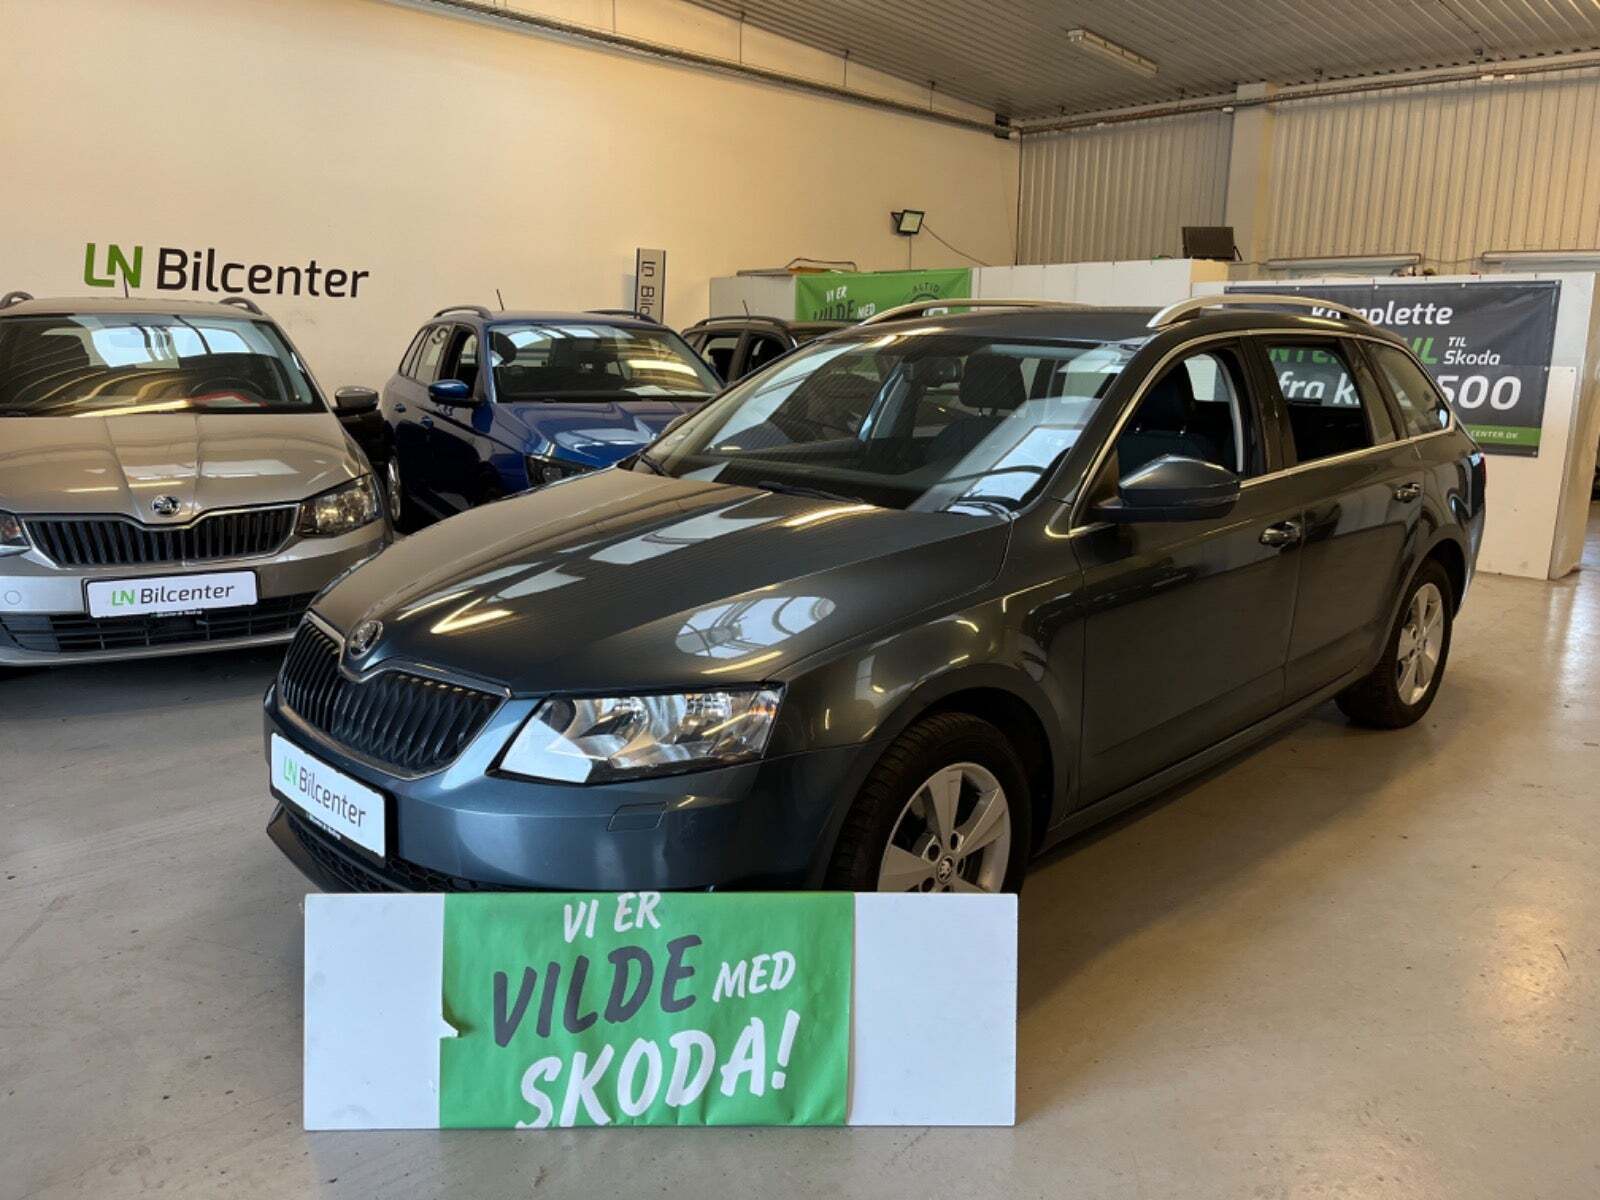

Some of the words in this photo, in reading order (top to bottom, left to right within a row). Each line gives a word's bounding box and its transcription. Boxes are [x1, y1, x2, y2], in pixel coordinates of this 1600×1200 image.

[84, 243, 143, 289] LN
[156, 247, 370, 298] Bilcenter
[640, 286, 655, 315] Bilc
[1443, 349, 1501, 366] Skoda
[1448, 336, 1467, 348] TIL
[1279, 371, 1325, 400] fra
[1332, 372, 1360, 405] k
[1437, 375, 1522, 411] 500
[1470, 430, 1518, 439] CENTER.DK
[111, 589, 136, 607] LN
[140, 584, 235, 605] Bilcenter
[283, 755, 298, 787] LN
[298, 766, 367, 828] Bilcenter
[563, 900, 599, 943] VI
[613, 892, 661, 933] ER
[493, 934, 703, 1048] VILDE
[711, 950, 797, 1003] MED
[515, 1009, 801, 1129] SKODA!
